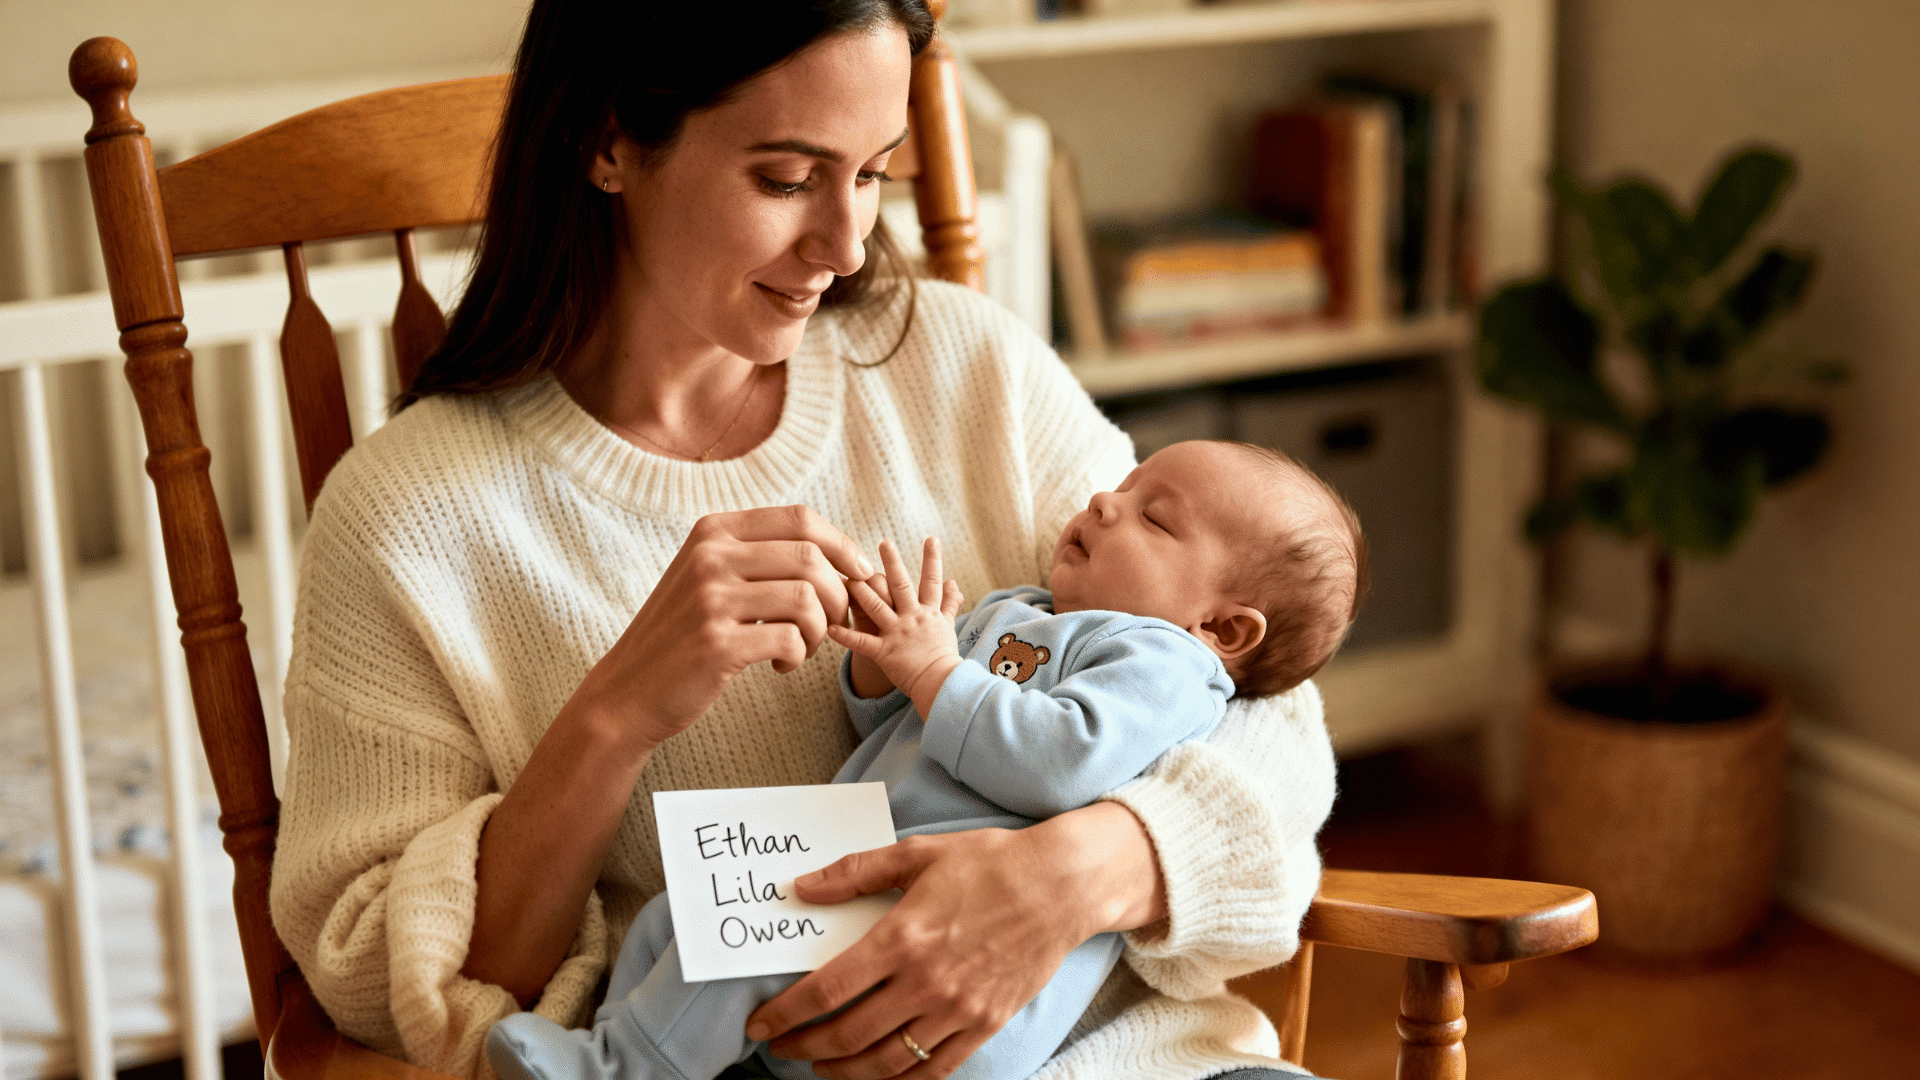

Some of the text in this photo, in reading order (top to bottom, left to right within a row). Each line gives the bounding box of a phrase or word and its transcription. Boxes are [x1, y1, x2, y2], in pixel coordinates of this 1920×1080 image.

[694, 822, 811, 860] Ethan
[711, 870, 787, 907] Lila
[720, 916, 825, 948] Owen
